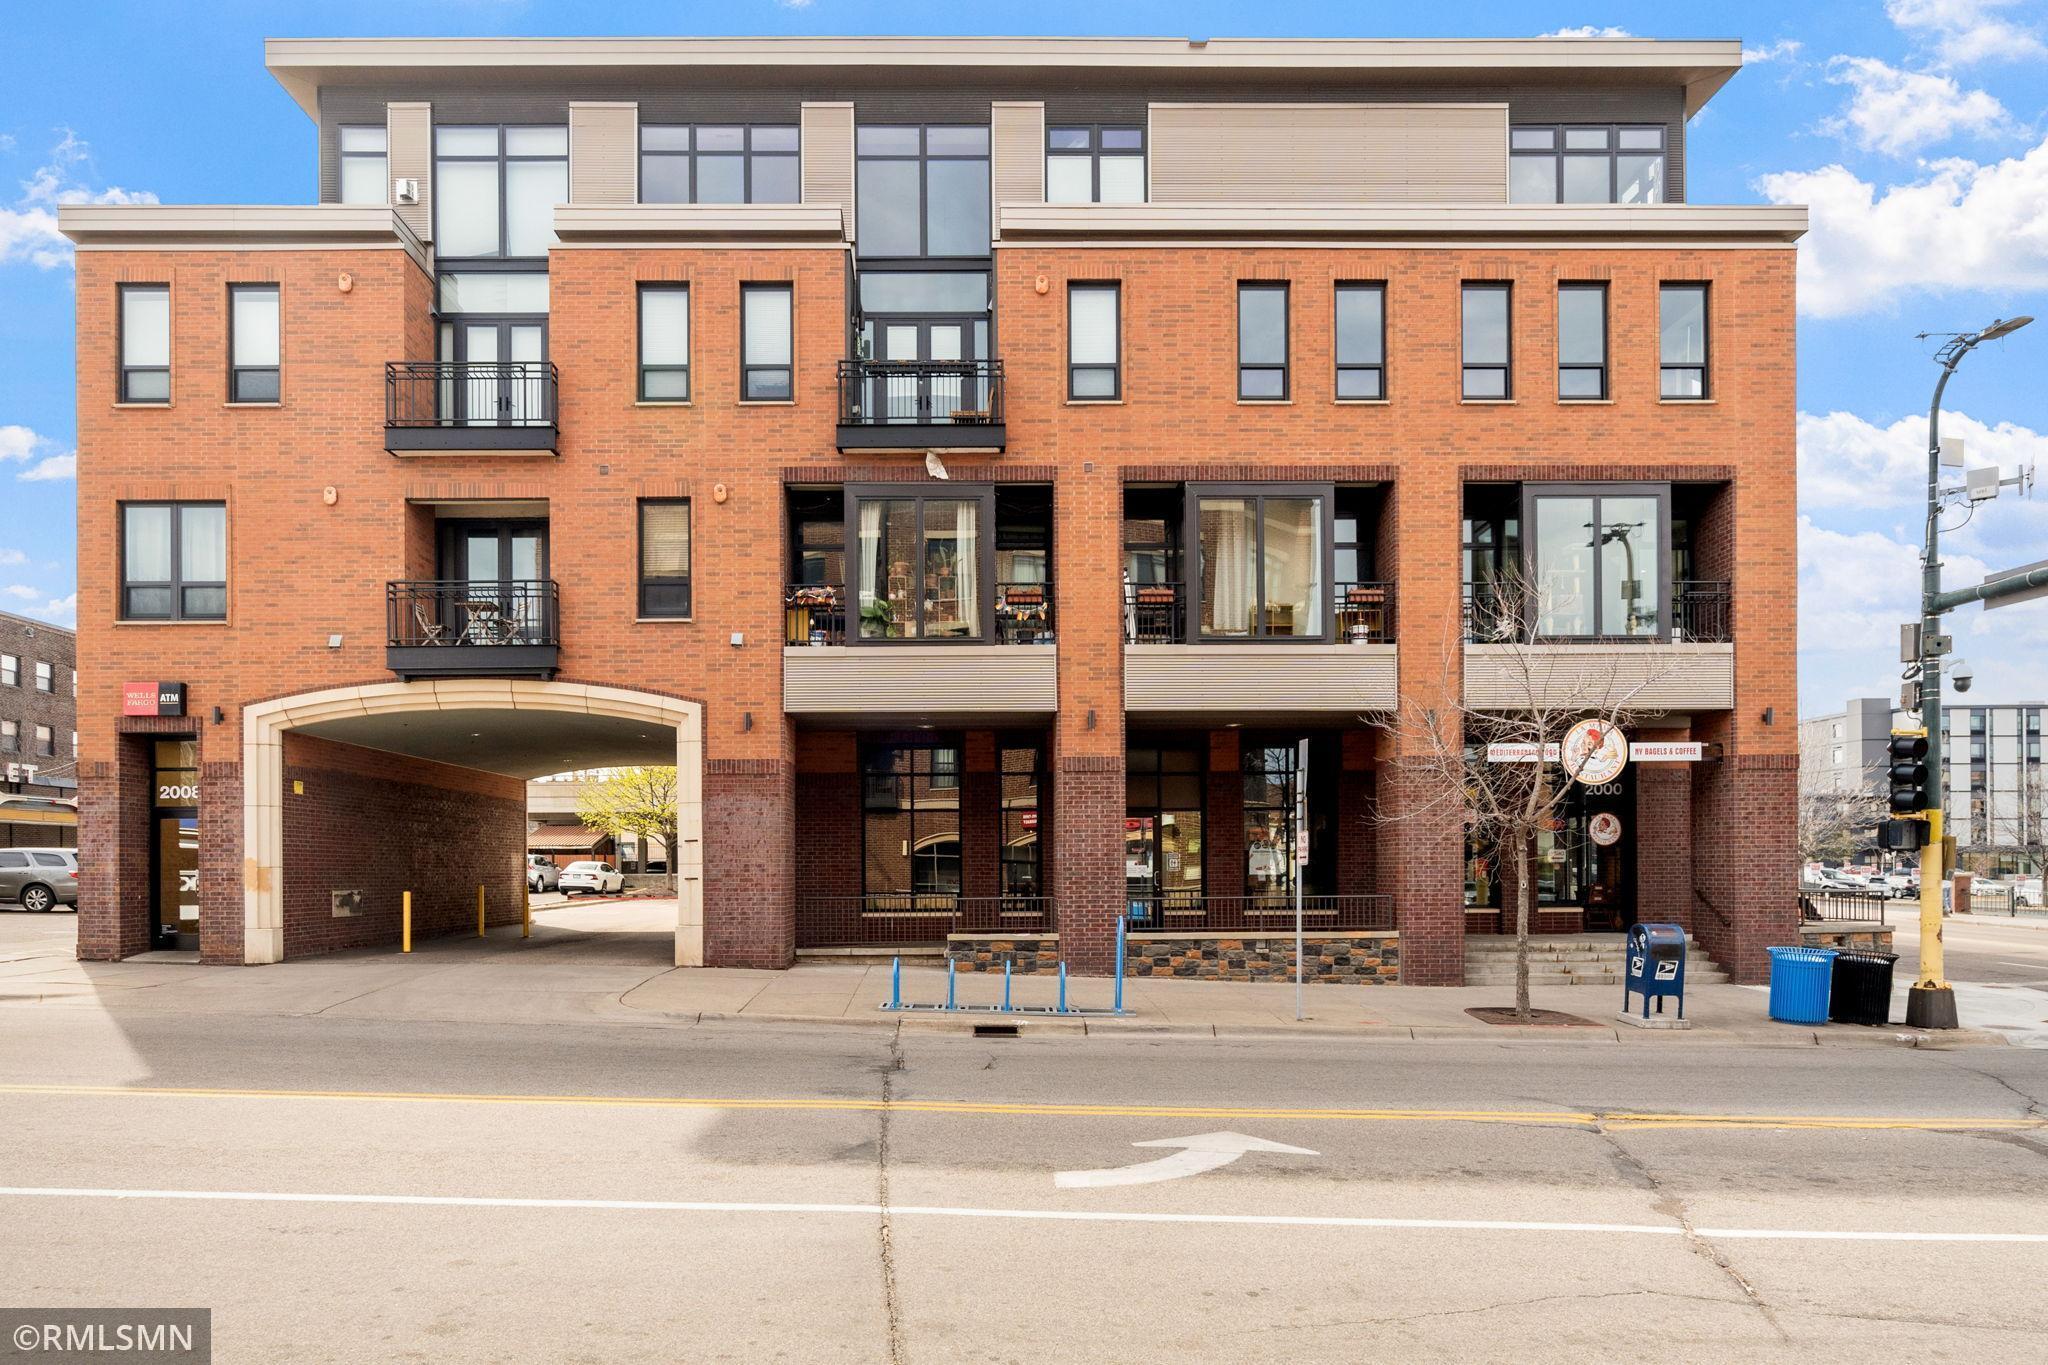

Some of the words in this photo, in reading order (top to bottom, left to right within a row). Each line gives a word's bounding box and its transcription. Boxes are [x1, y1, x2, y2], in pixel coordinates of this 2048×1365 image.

[160, 693, 179, 702] ATM
[1543, 748, 1558, 756] OOD
[1634, 747, 1643, 756] NY
[1645, 747, 1668, 756] BAGELS
[1675, 747, 1697, 755] COFFEE
[0, 762, 38, 784] ET
[160, 785, 198, 799] 2008
[1585, 783, 1622, 795] 2000
